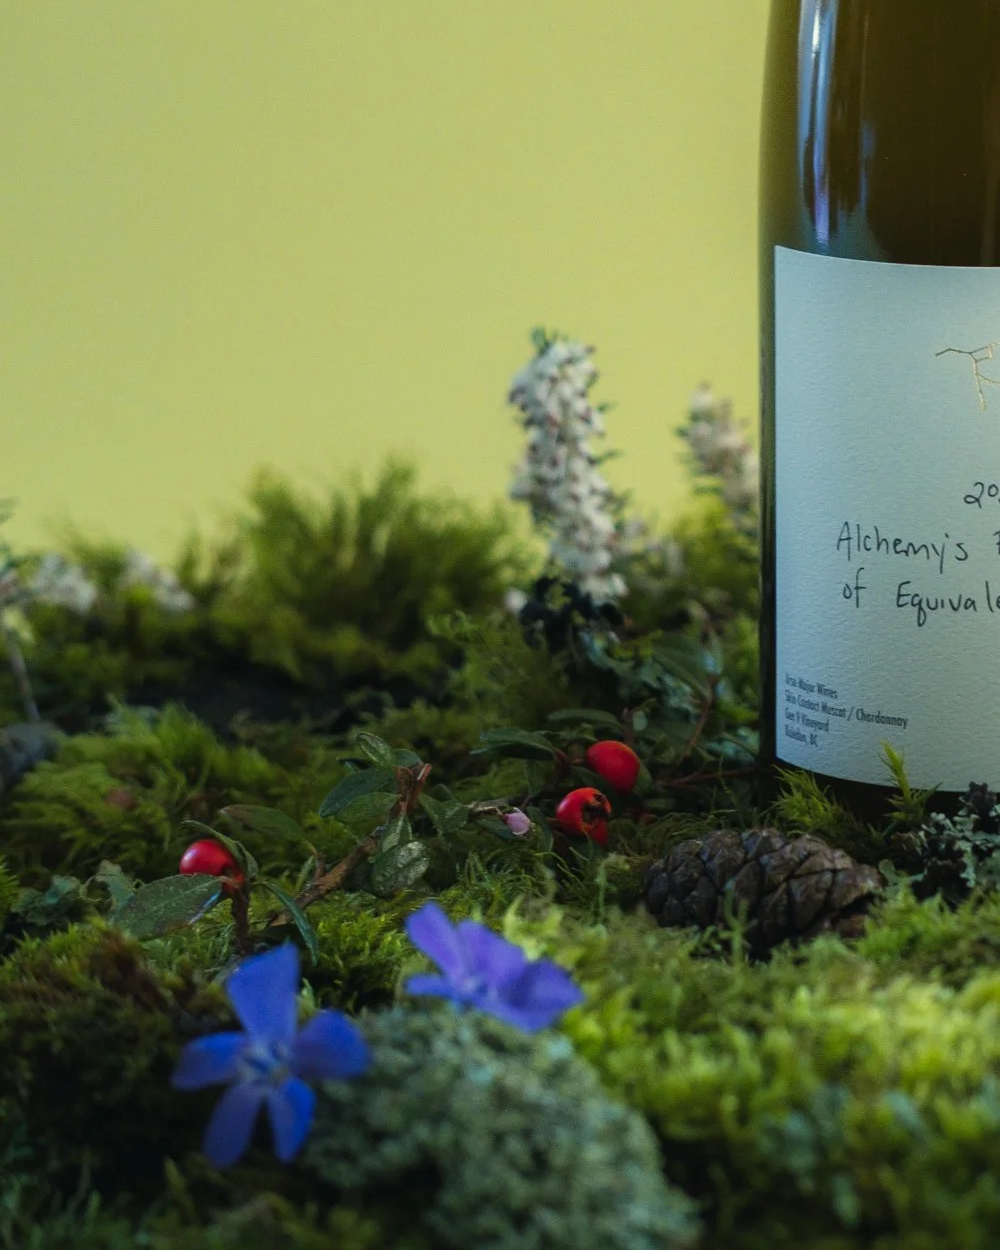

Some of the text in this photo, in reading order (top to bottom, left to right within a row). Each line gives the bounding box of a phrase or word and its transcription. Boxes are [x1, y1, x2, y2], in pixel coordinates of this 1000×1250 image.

[836, 521, 969, 574] Alchemy's
[842, 567, 867, 608] of
[816, 683, 838, 699] Wines
[821, 702, 846, 718] Muscat
[847, 706, 854, 722] /
[856, 708, 908, 730] Chardonnay
